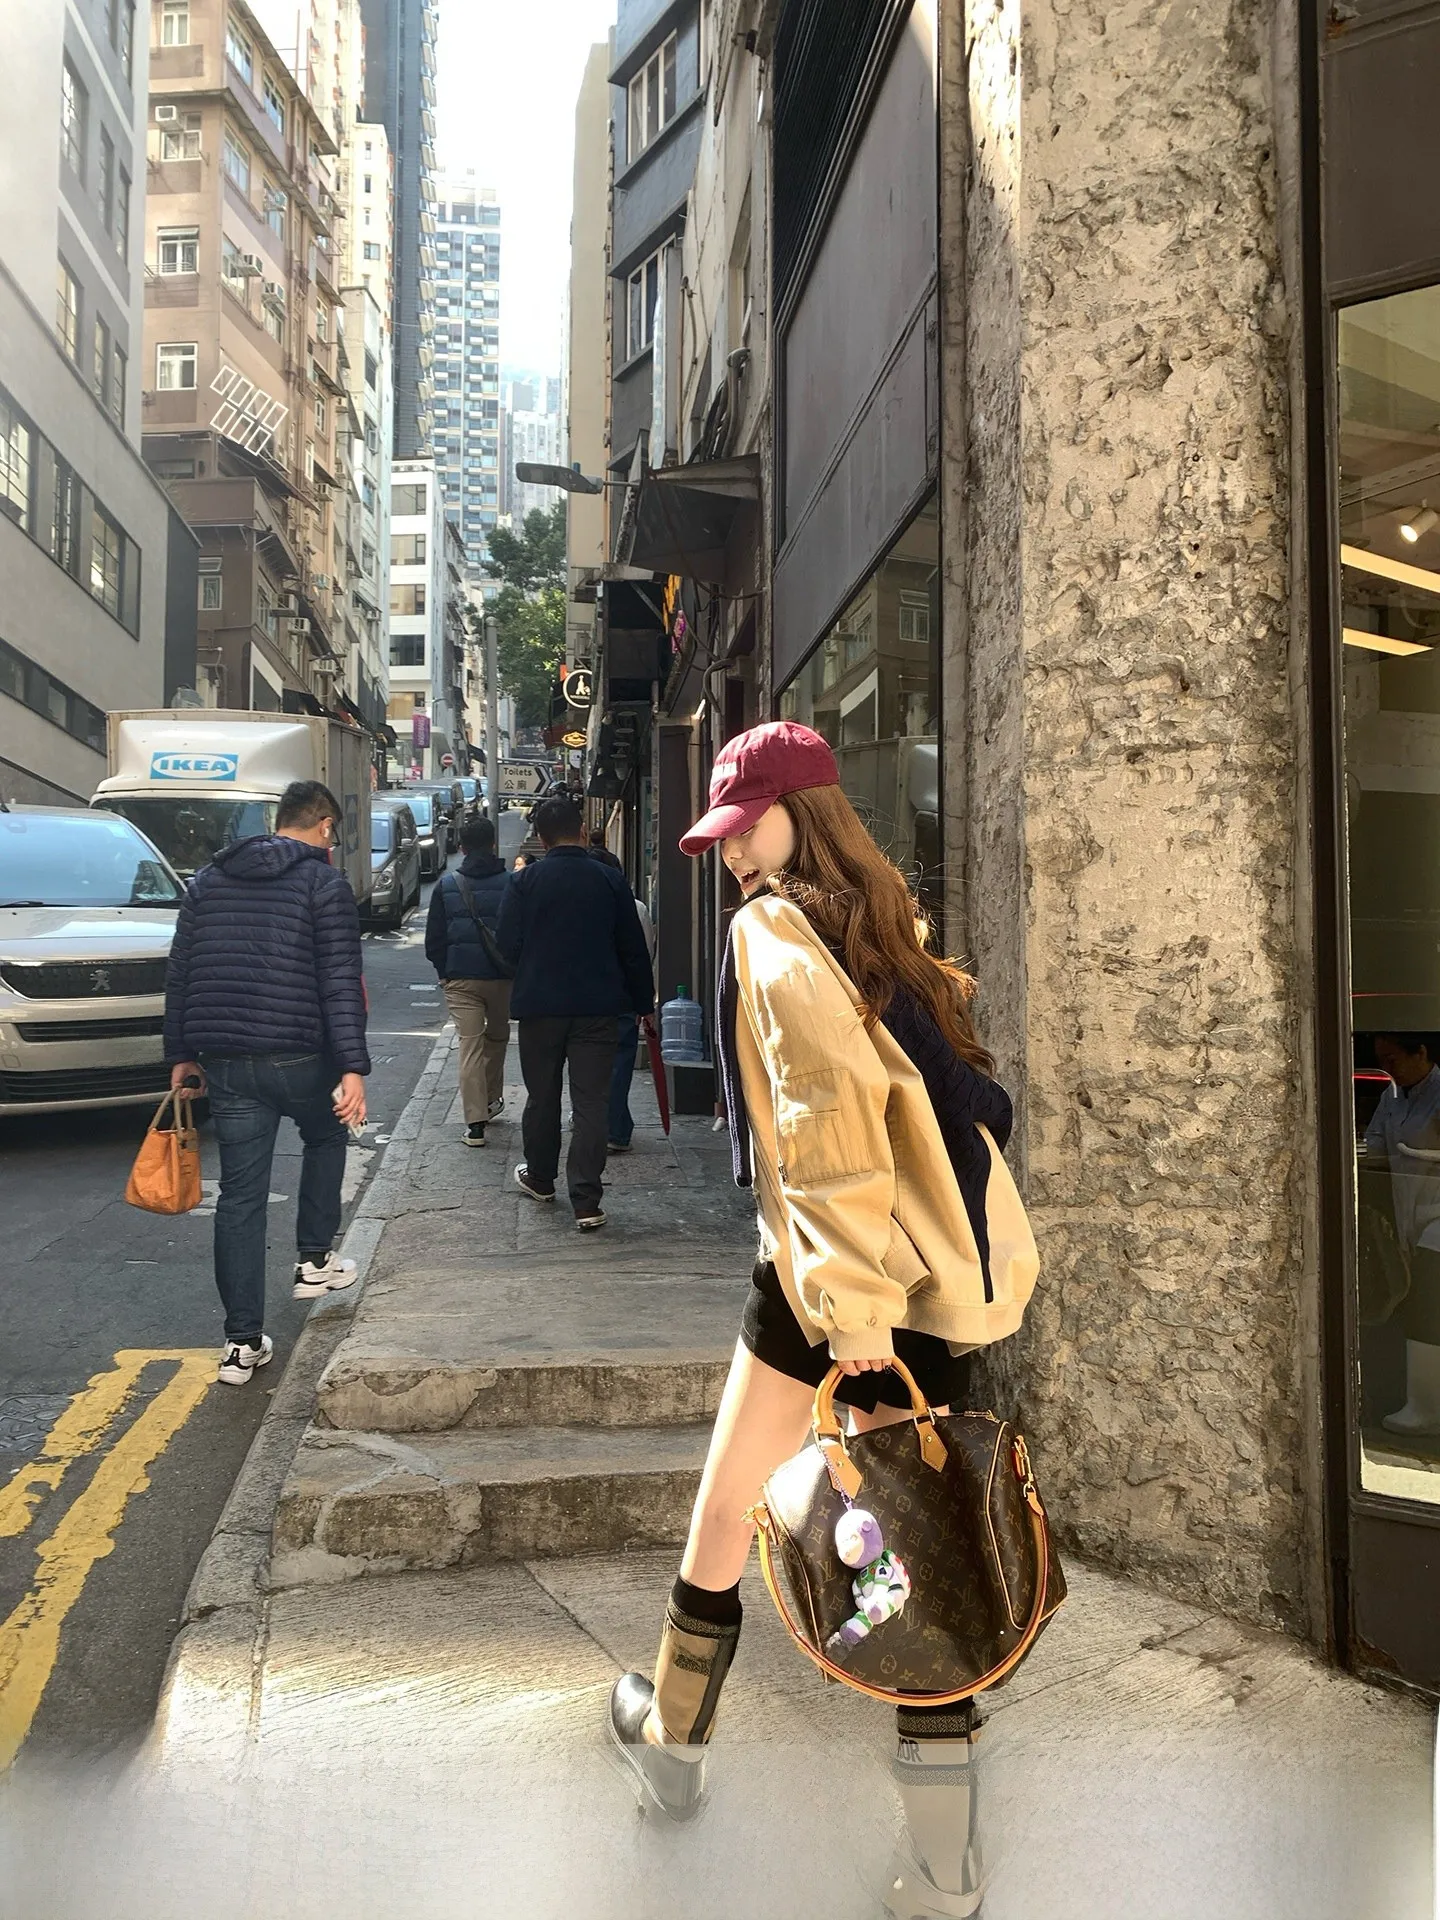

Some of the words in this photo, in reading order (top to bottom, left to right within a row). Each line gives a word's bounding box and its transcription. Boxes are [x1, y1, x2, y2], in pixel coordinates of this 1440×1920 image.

[160, 759, 229, 771] IKEA
[503, 767, 533, 777] Toilets
[504, 779, 527, 791] 公廁
